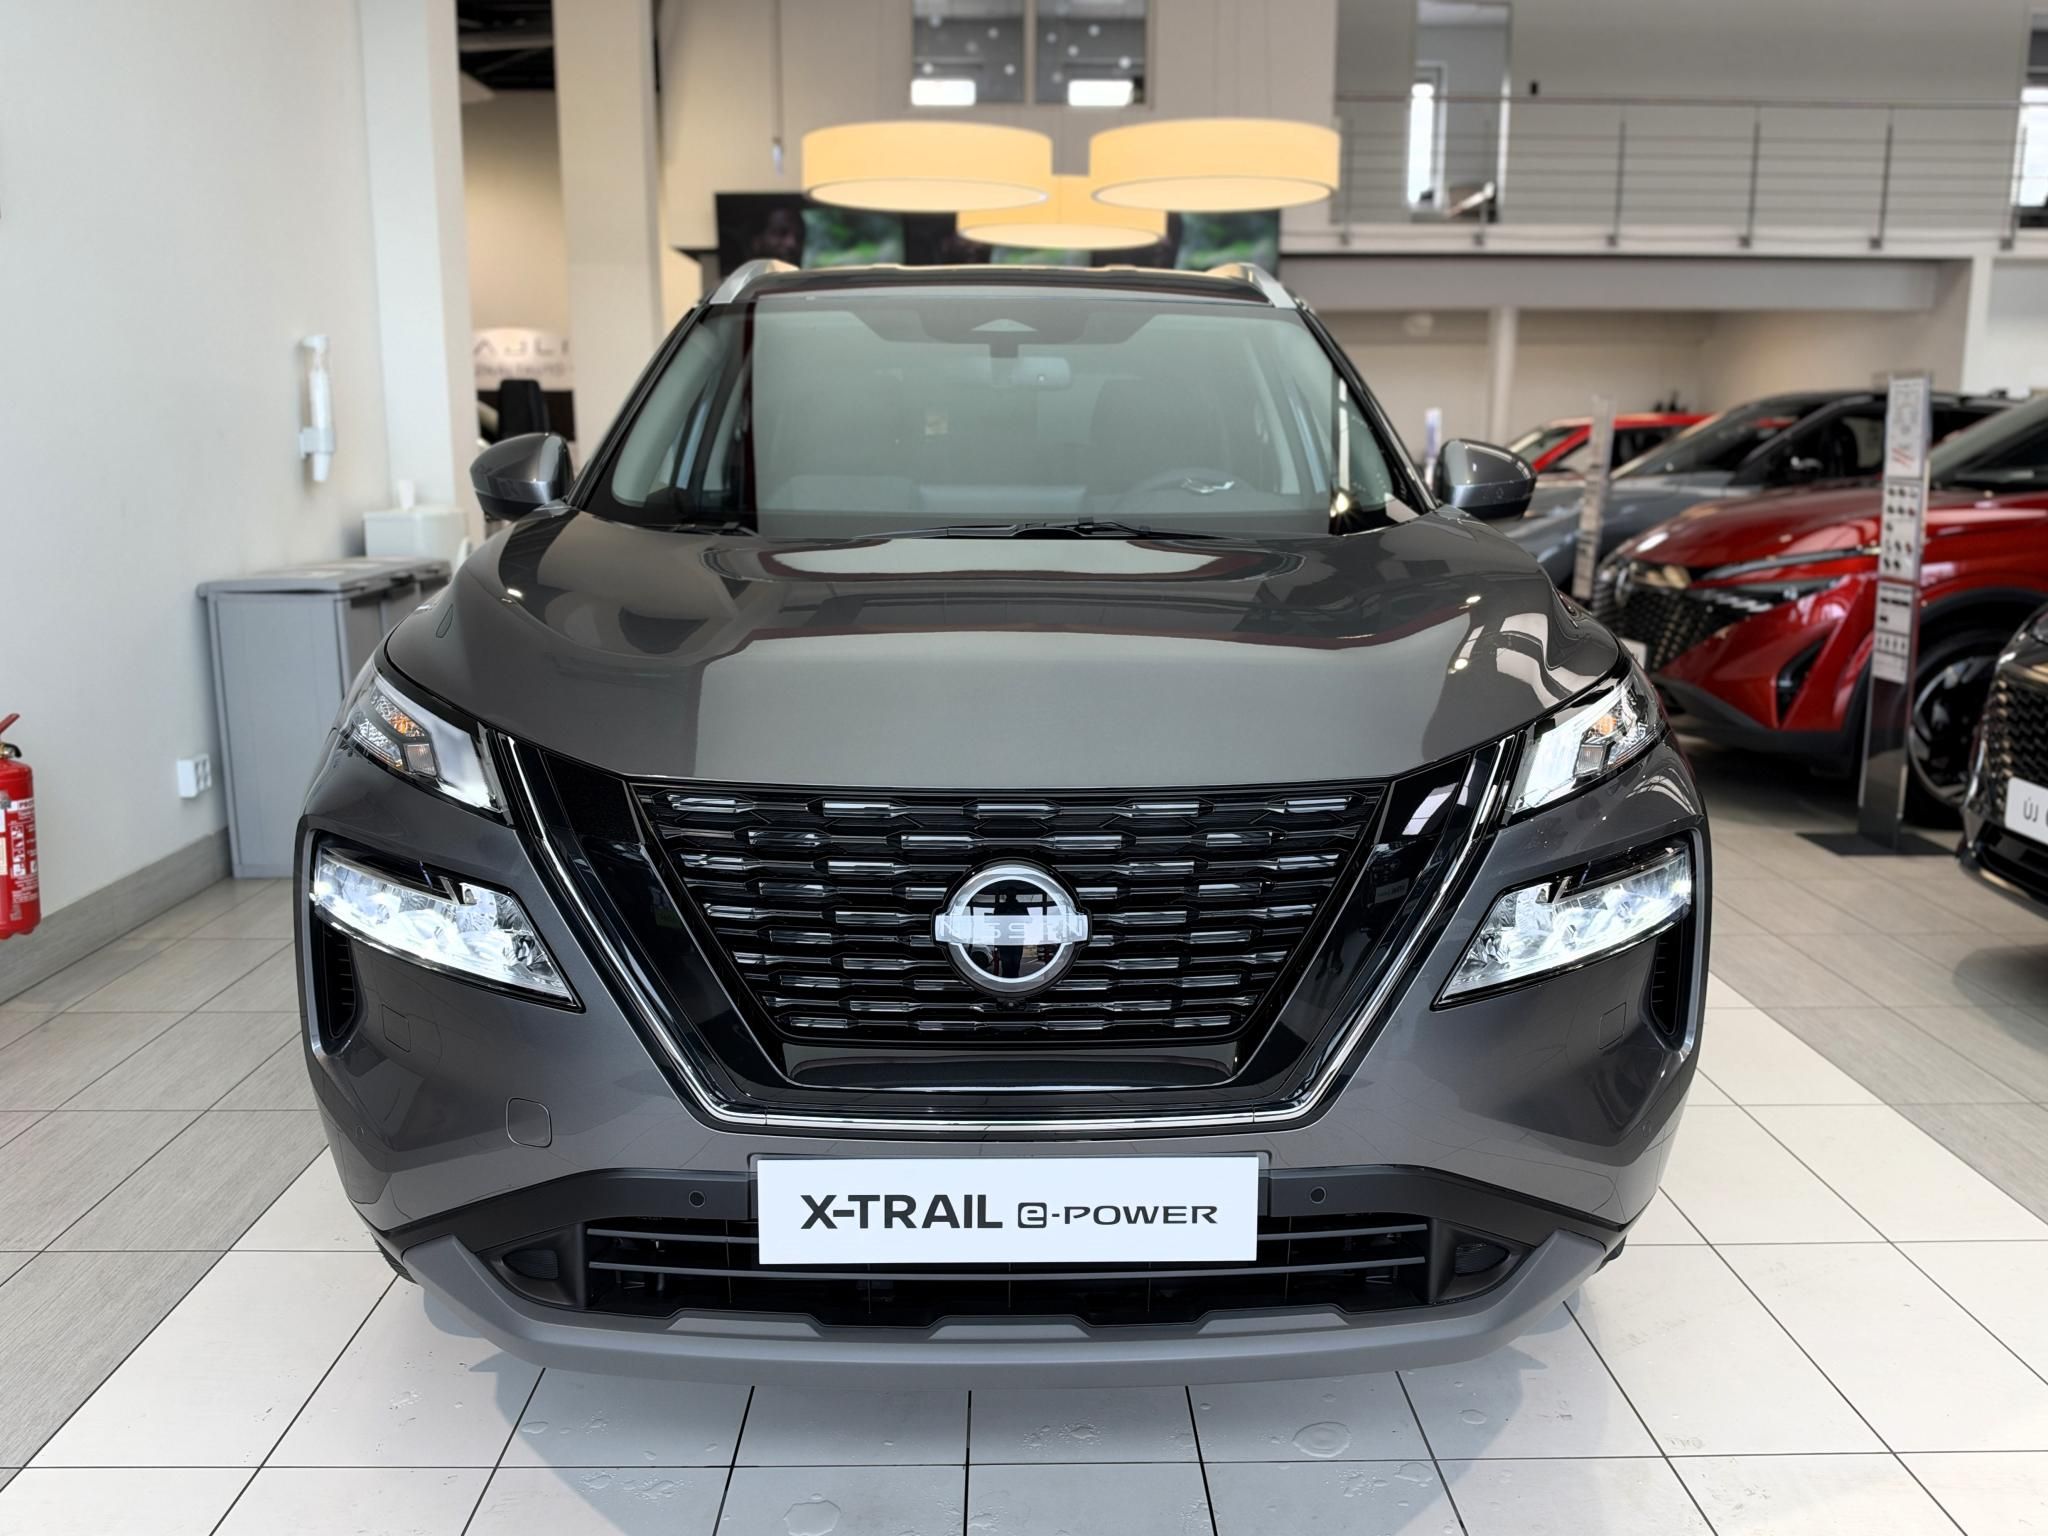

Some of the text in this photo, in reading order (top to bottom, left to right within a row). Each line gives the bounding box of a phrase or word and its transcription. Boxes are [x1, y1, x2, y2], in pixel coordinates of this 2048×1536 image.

[940, 919, 1083, 940] NSSN
[801, 1194, 1218, 1230] X-TRAIL e-POWER
